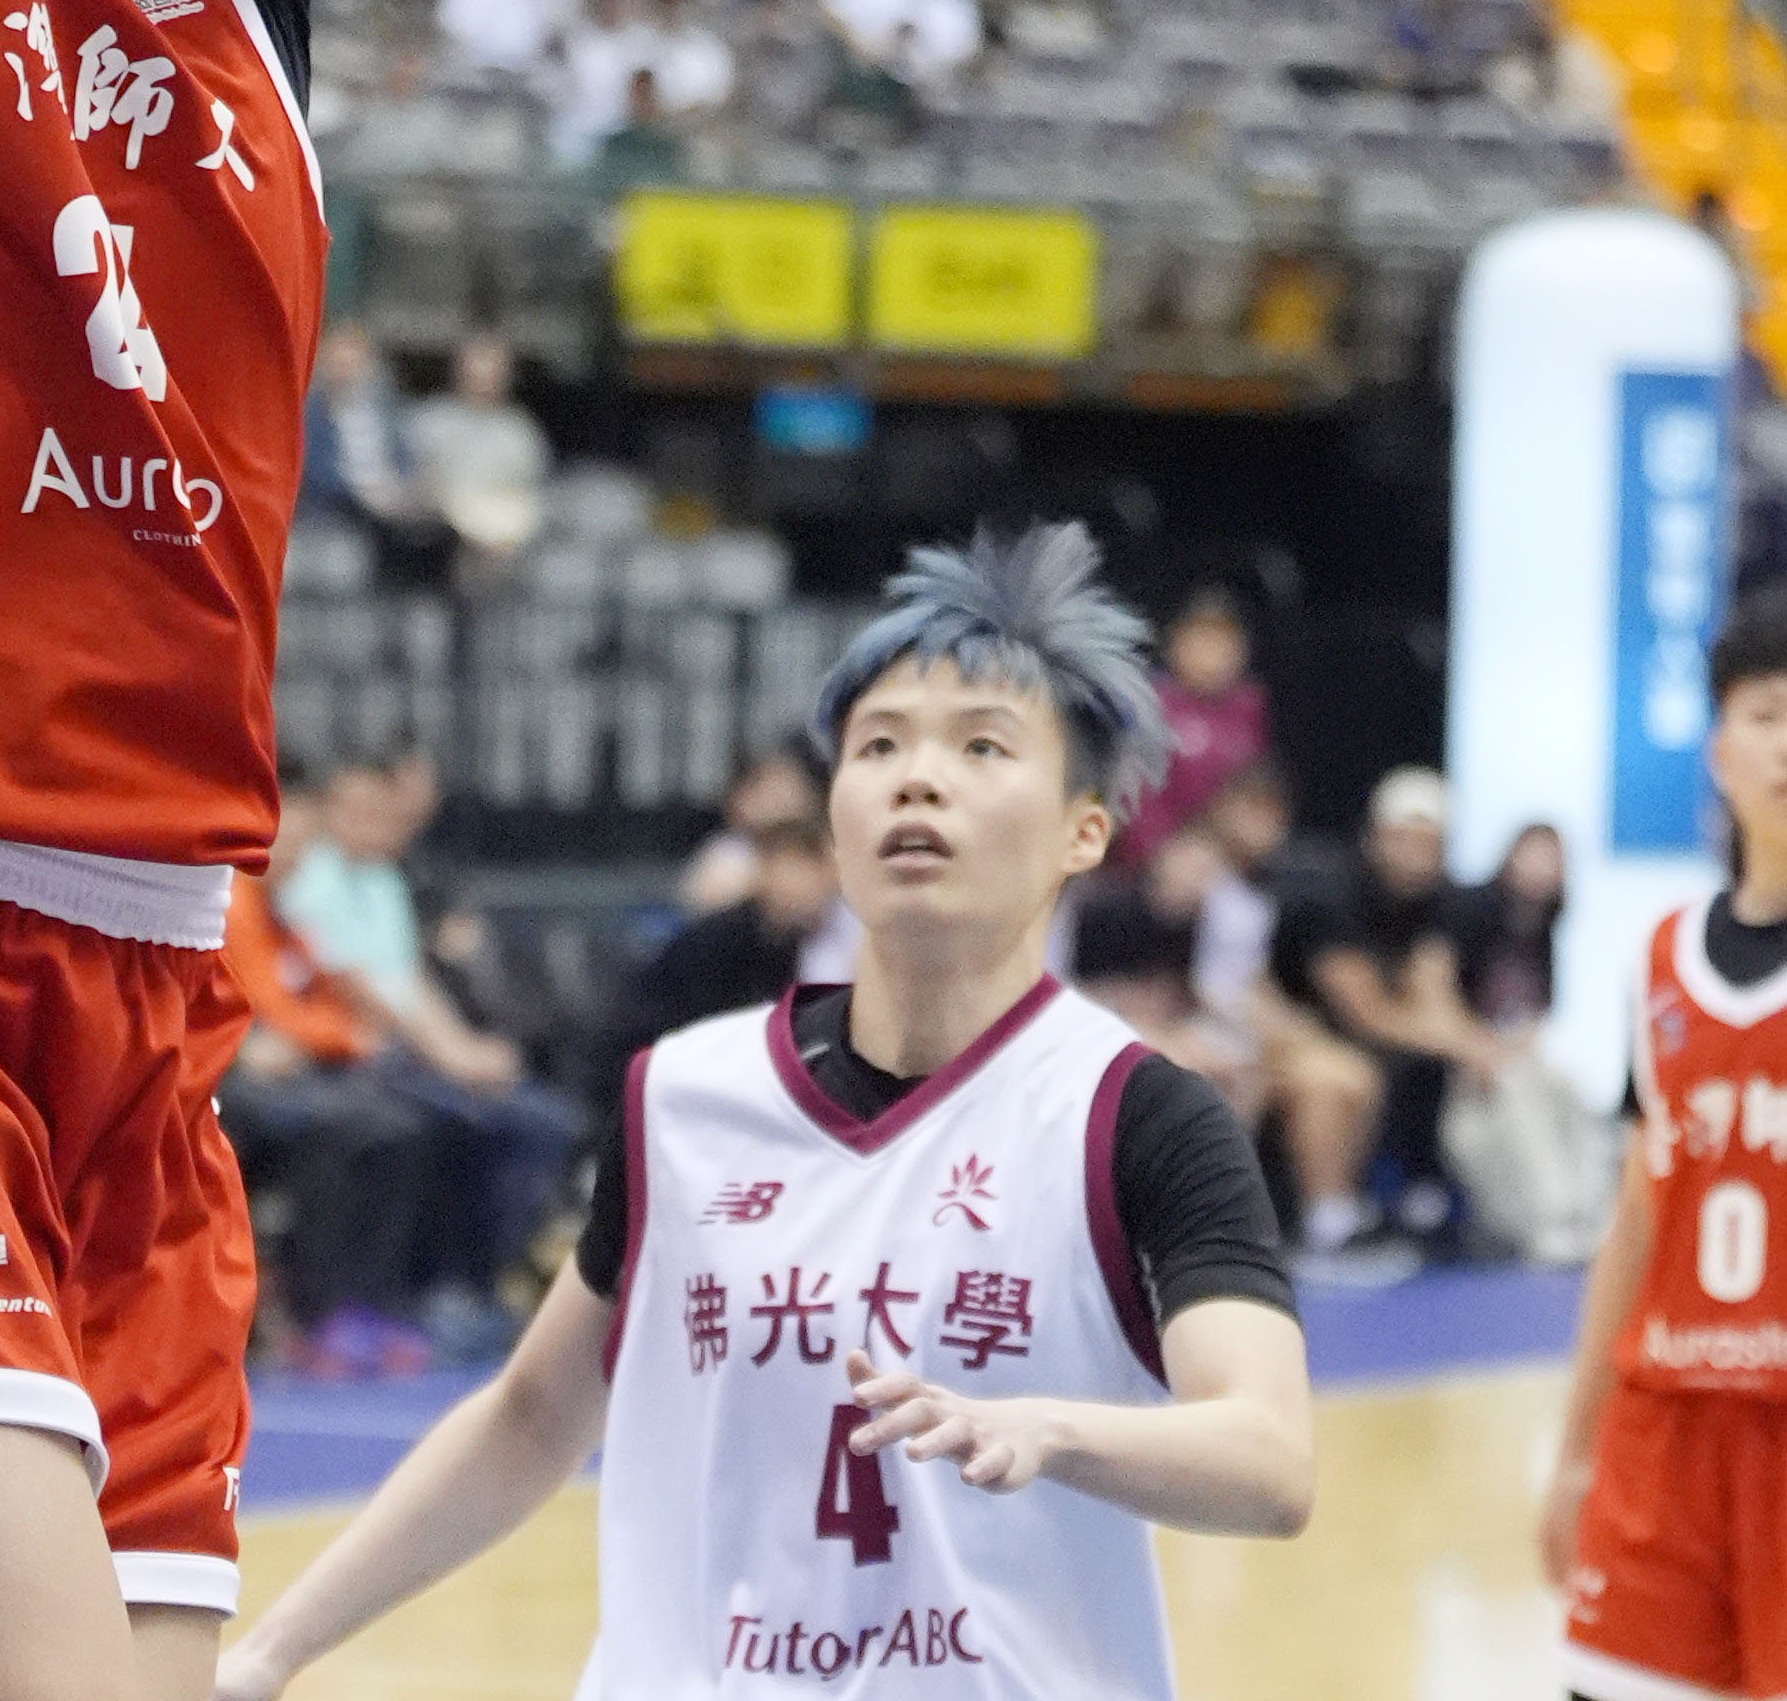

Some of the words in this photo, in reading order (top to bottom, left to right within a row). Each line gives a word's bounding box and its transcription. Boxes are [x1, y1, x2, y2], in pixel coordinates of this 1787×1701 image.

[1696, 1177, 1769, 1304] 0
[815, 1402, 902, 1568] 4
[722, 1606, 985, 1681] TutorABC
